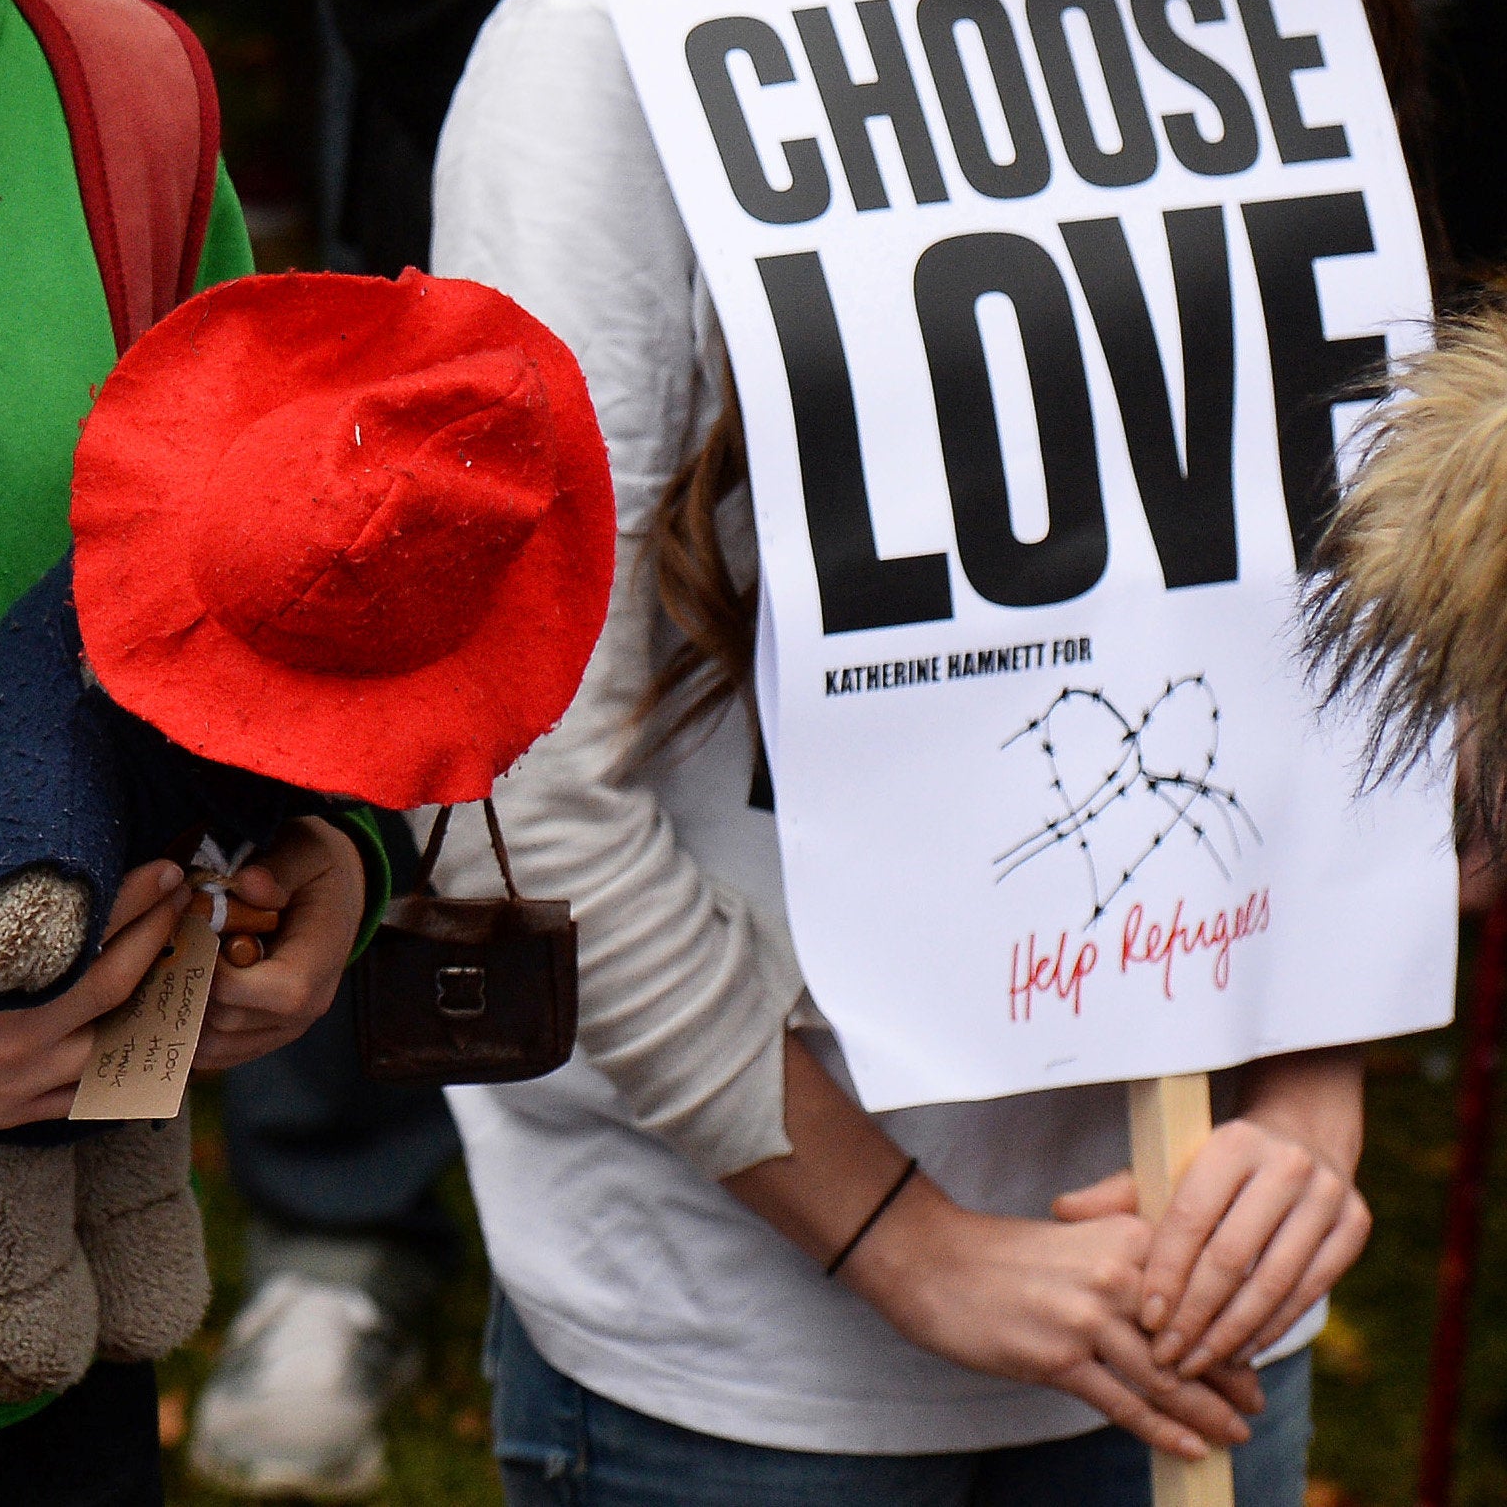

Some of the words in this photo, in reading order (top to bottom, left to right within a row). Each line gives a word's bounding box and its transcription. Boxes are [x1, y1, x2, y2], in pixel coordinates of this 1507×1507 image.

[825, 656, 942, 697] KATHERINE
[947, 642, 1044, 680] HAMNETT
[1052, 636, 1093, 664] FOR
[1009, 931, 1099, 1022] Help
[1120, 887, 1271, 1000] Refugees
